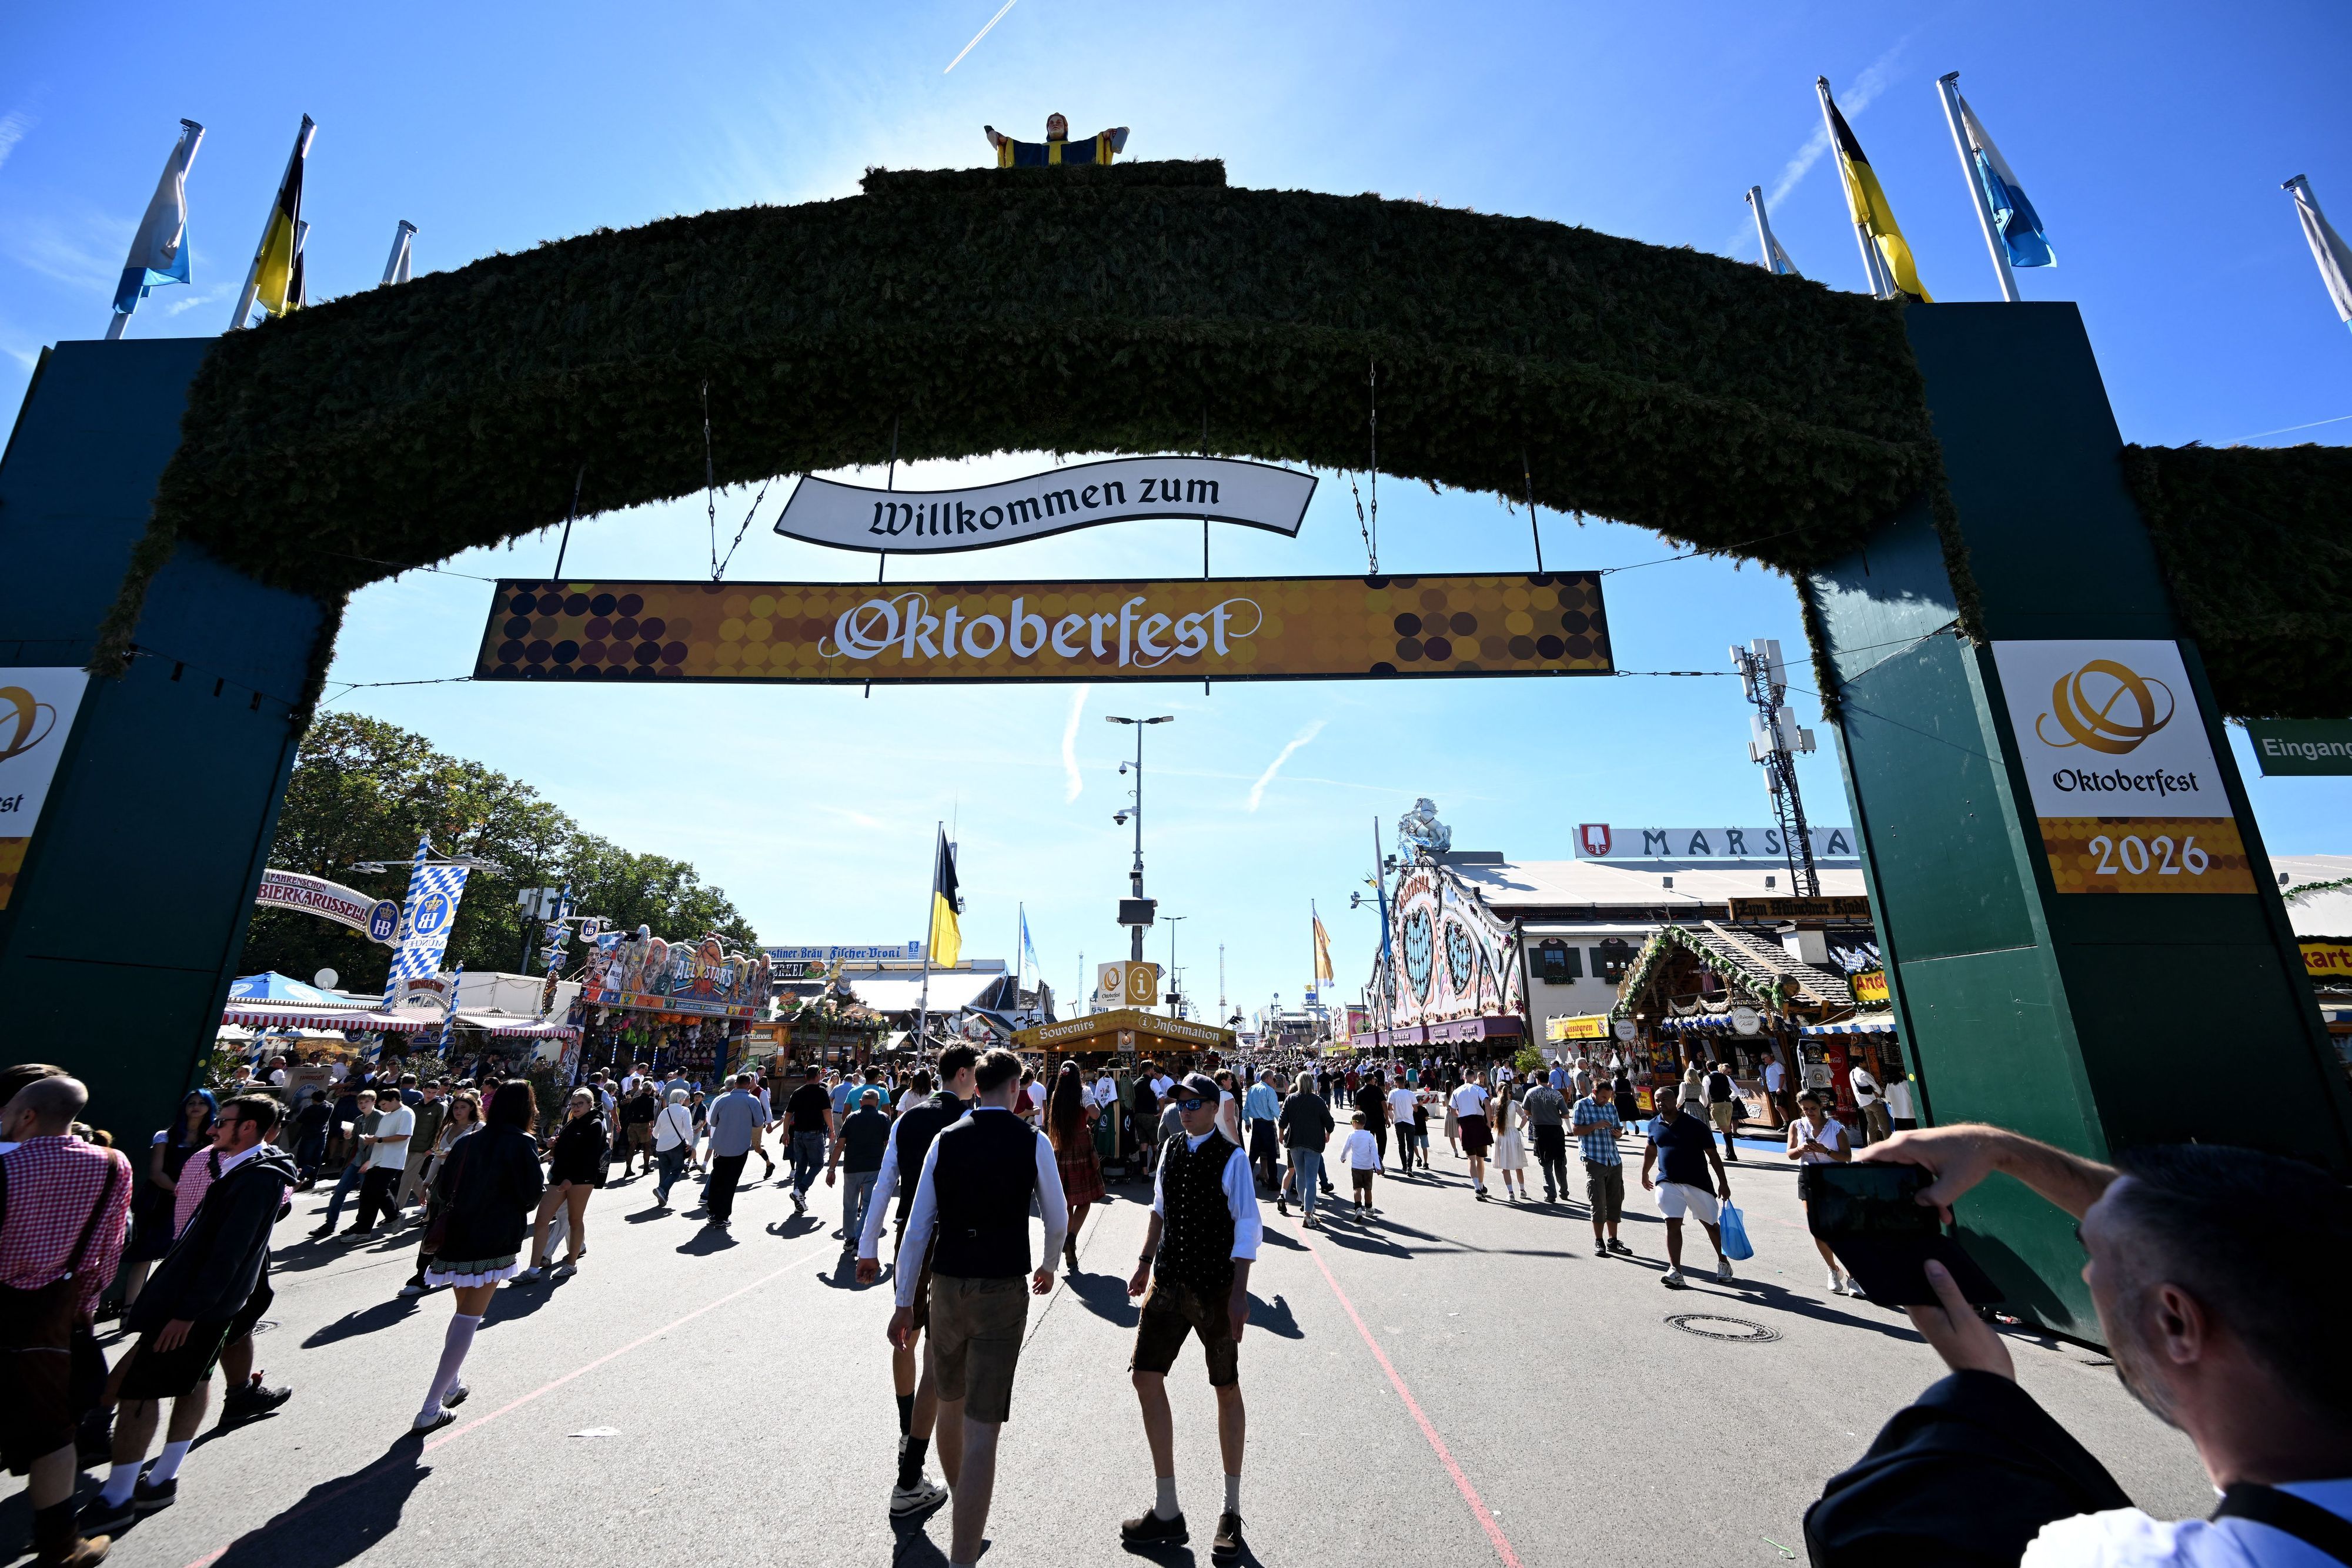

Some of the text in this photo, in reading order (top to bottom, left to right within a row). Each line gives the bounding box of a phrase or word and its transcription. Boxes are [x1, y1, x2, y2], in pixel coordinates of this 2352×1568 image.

[868, 477, 1220, 536] Willkommen zum
[818, 591, 1262, 668] Oktoberfest
[2053, 768, 2199, 797] Oktoberfest
[2089, 835, 2209, 875] 2026
[270, 873, 327, 891] FAHRENSCHON
[257, 884, 367, 923] BIERKARUSSELL
[373, 920, 391, 936] HB
[674, 959, 733, 987] ALL STARS
[1039, 1018, 1095, 1040] Souvenirs
[1154, 1018, 1220, 1041] Information
